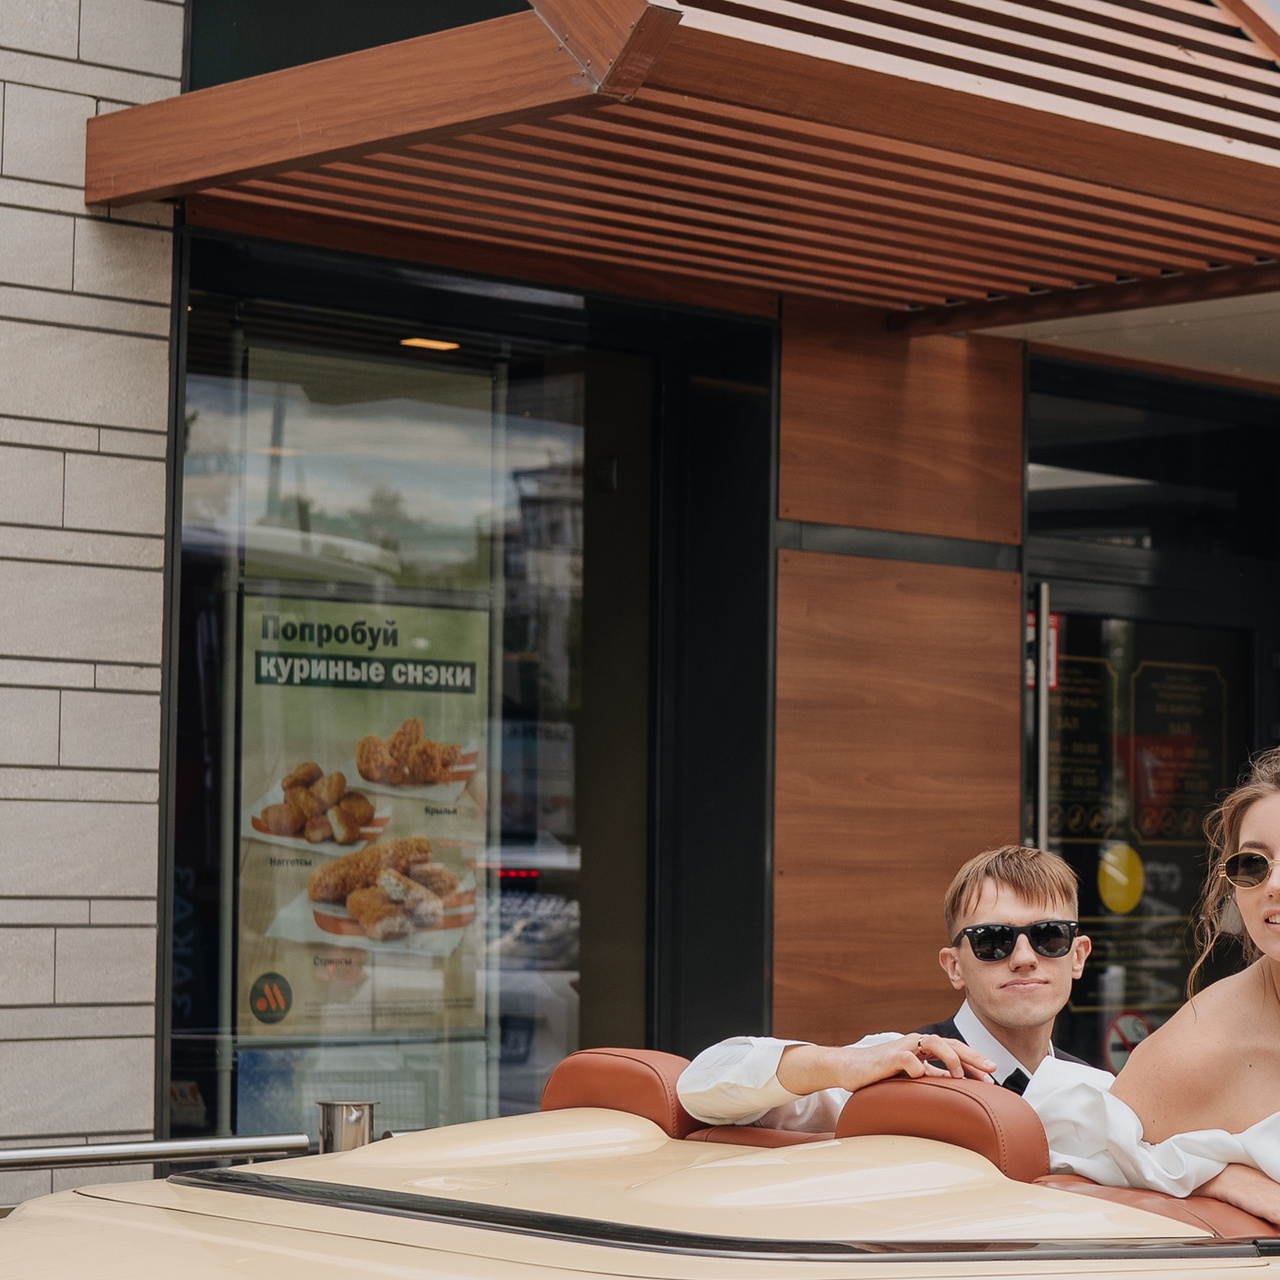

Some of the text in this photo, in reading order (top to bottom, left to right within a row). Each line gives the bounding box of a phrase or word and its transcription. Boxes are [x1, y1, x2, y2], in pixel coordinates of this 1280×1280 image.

[261, 614, 398, 651] Попробуй
[260, 656, 472, 688] куриные снэки
[424, 805, 458, 816] Крылья
